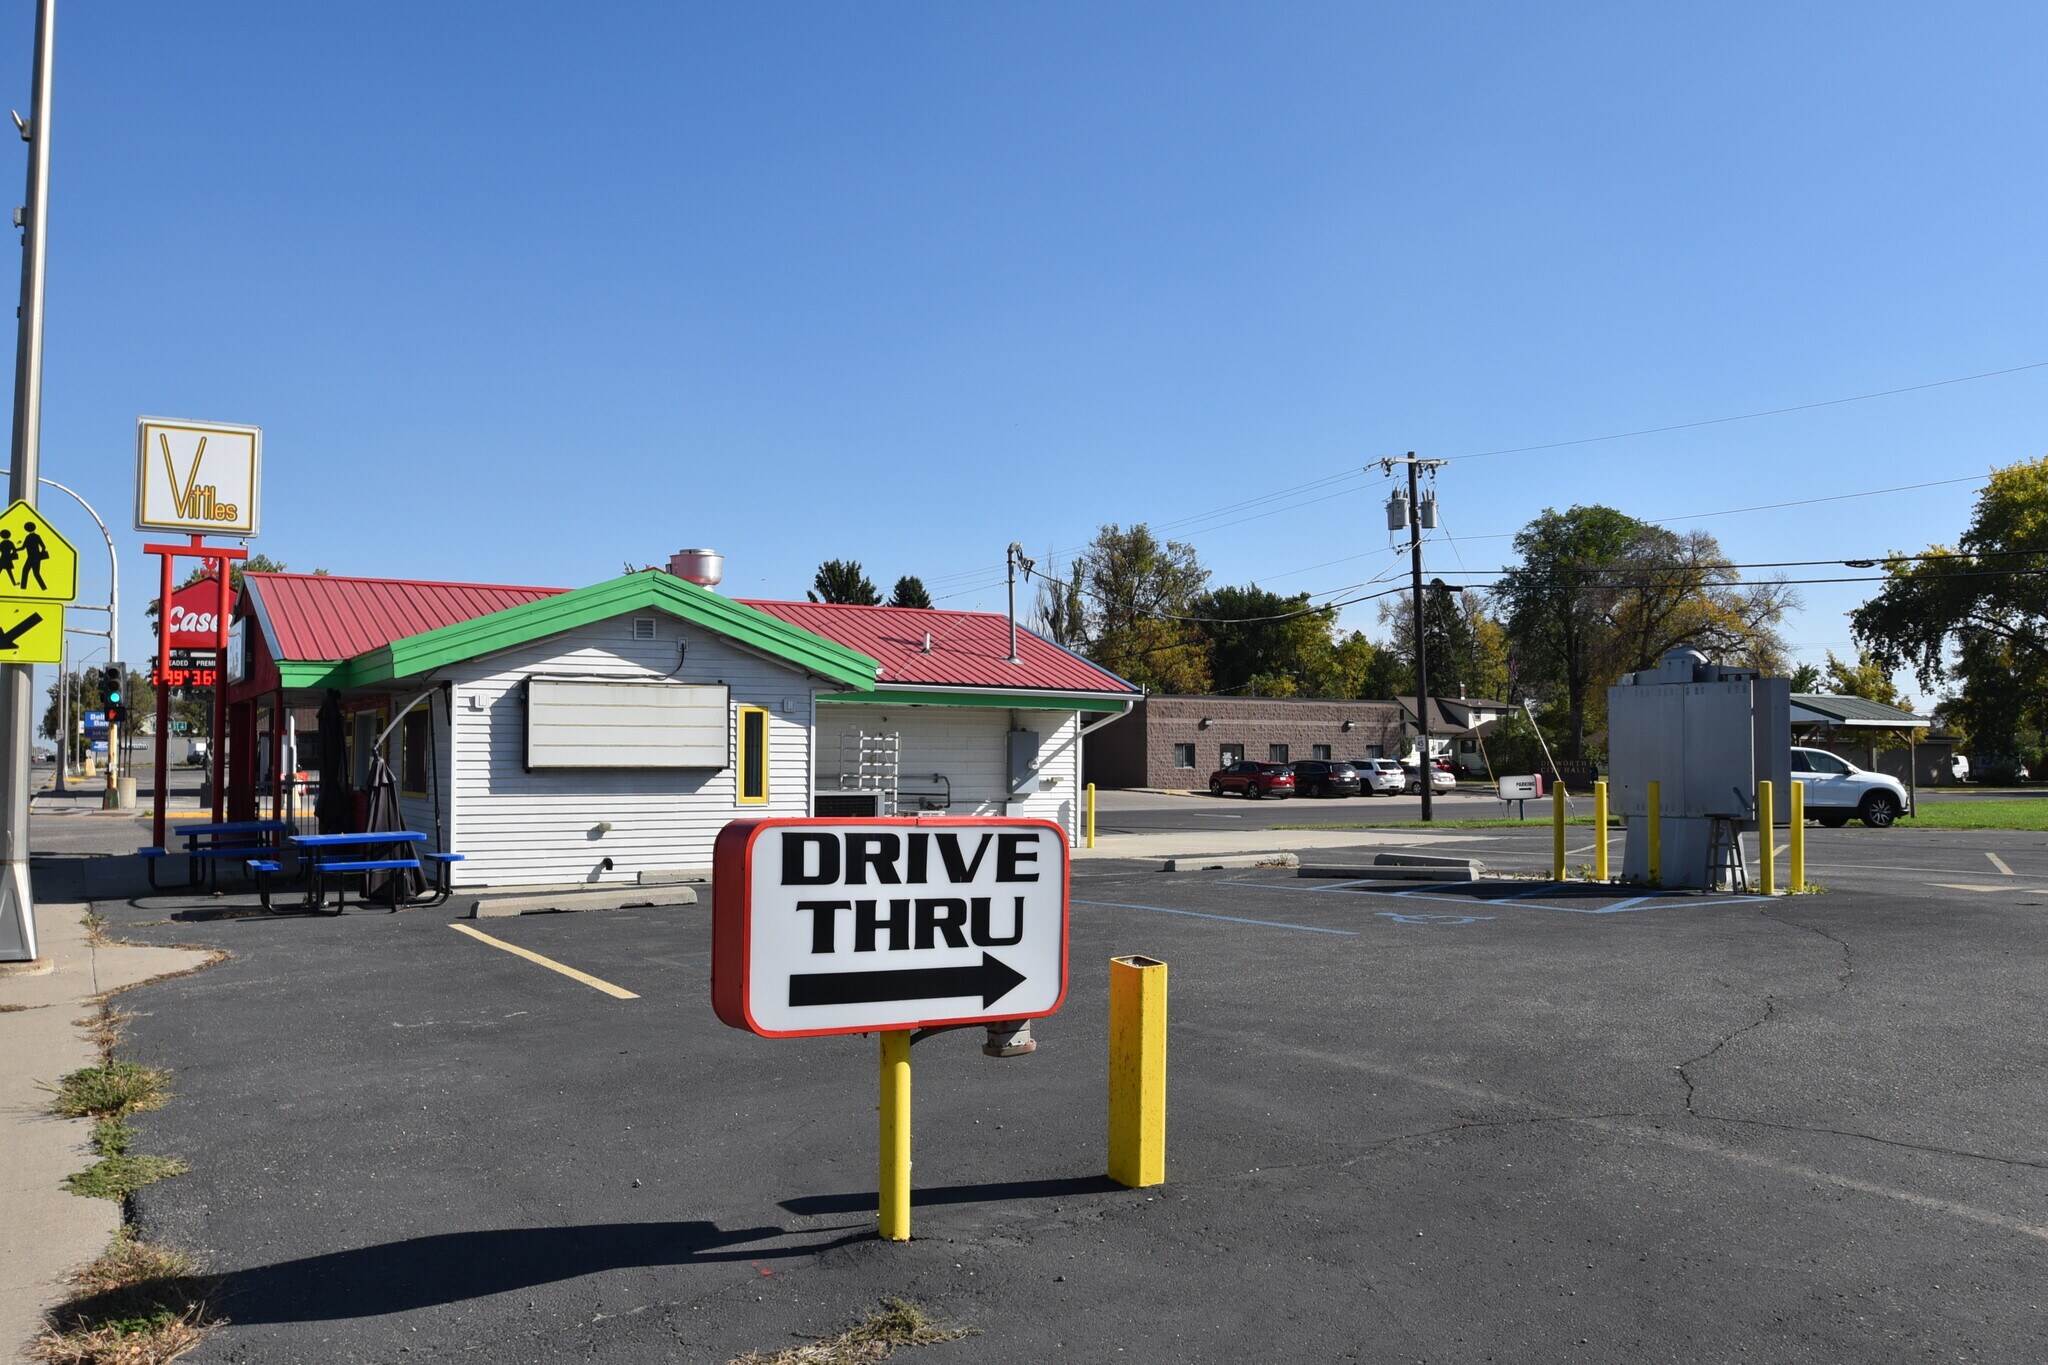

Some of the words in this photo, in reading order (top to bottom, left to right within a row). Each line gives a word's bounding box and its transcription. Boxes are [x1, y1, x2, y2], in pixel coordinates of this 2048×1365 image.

[160, 433, 238, 522] Vittles
[170, 605, 233, 634] Case
[90, 713, 105, 721] Bell
[780, 832, 1040, 886] DRIVE
[796, 896, 1025, 954] THRU
